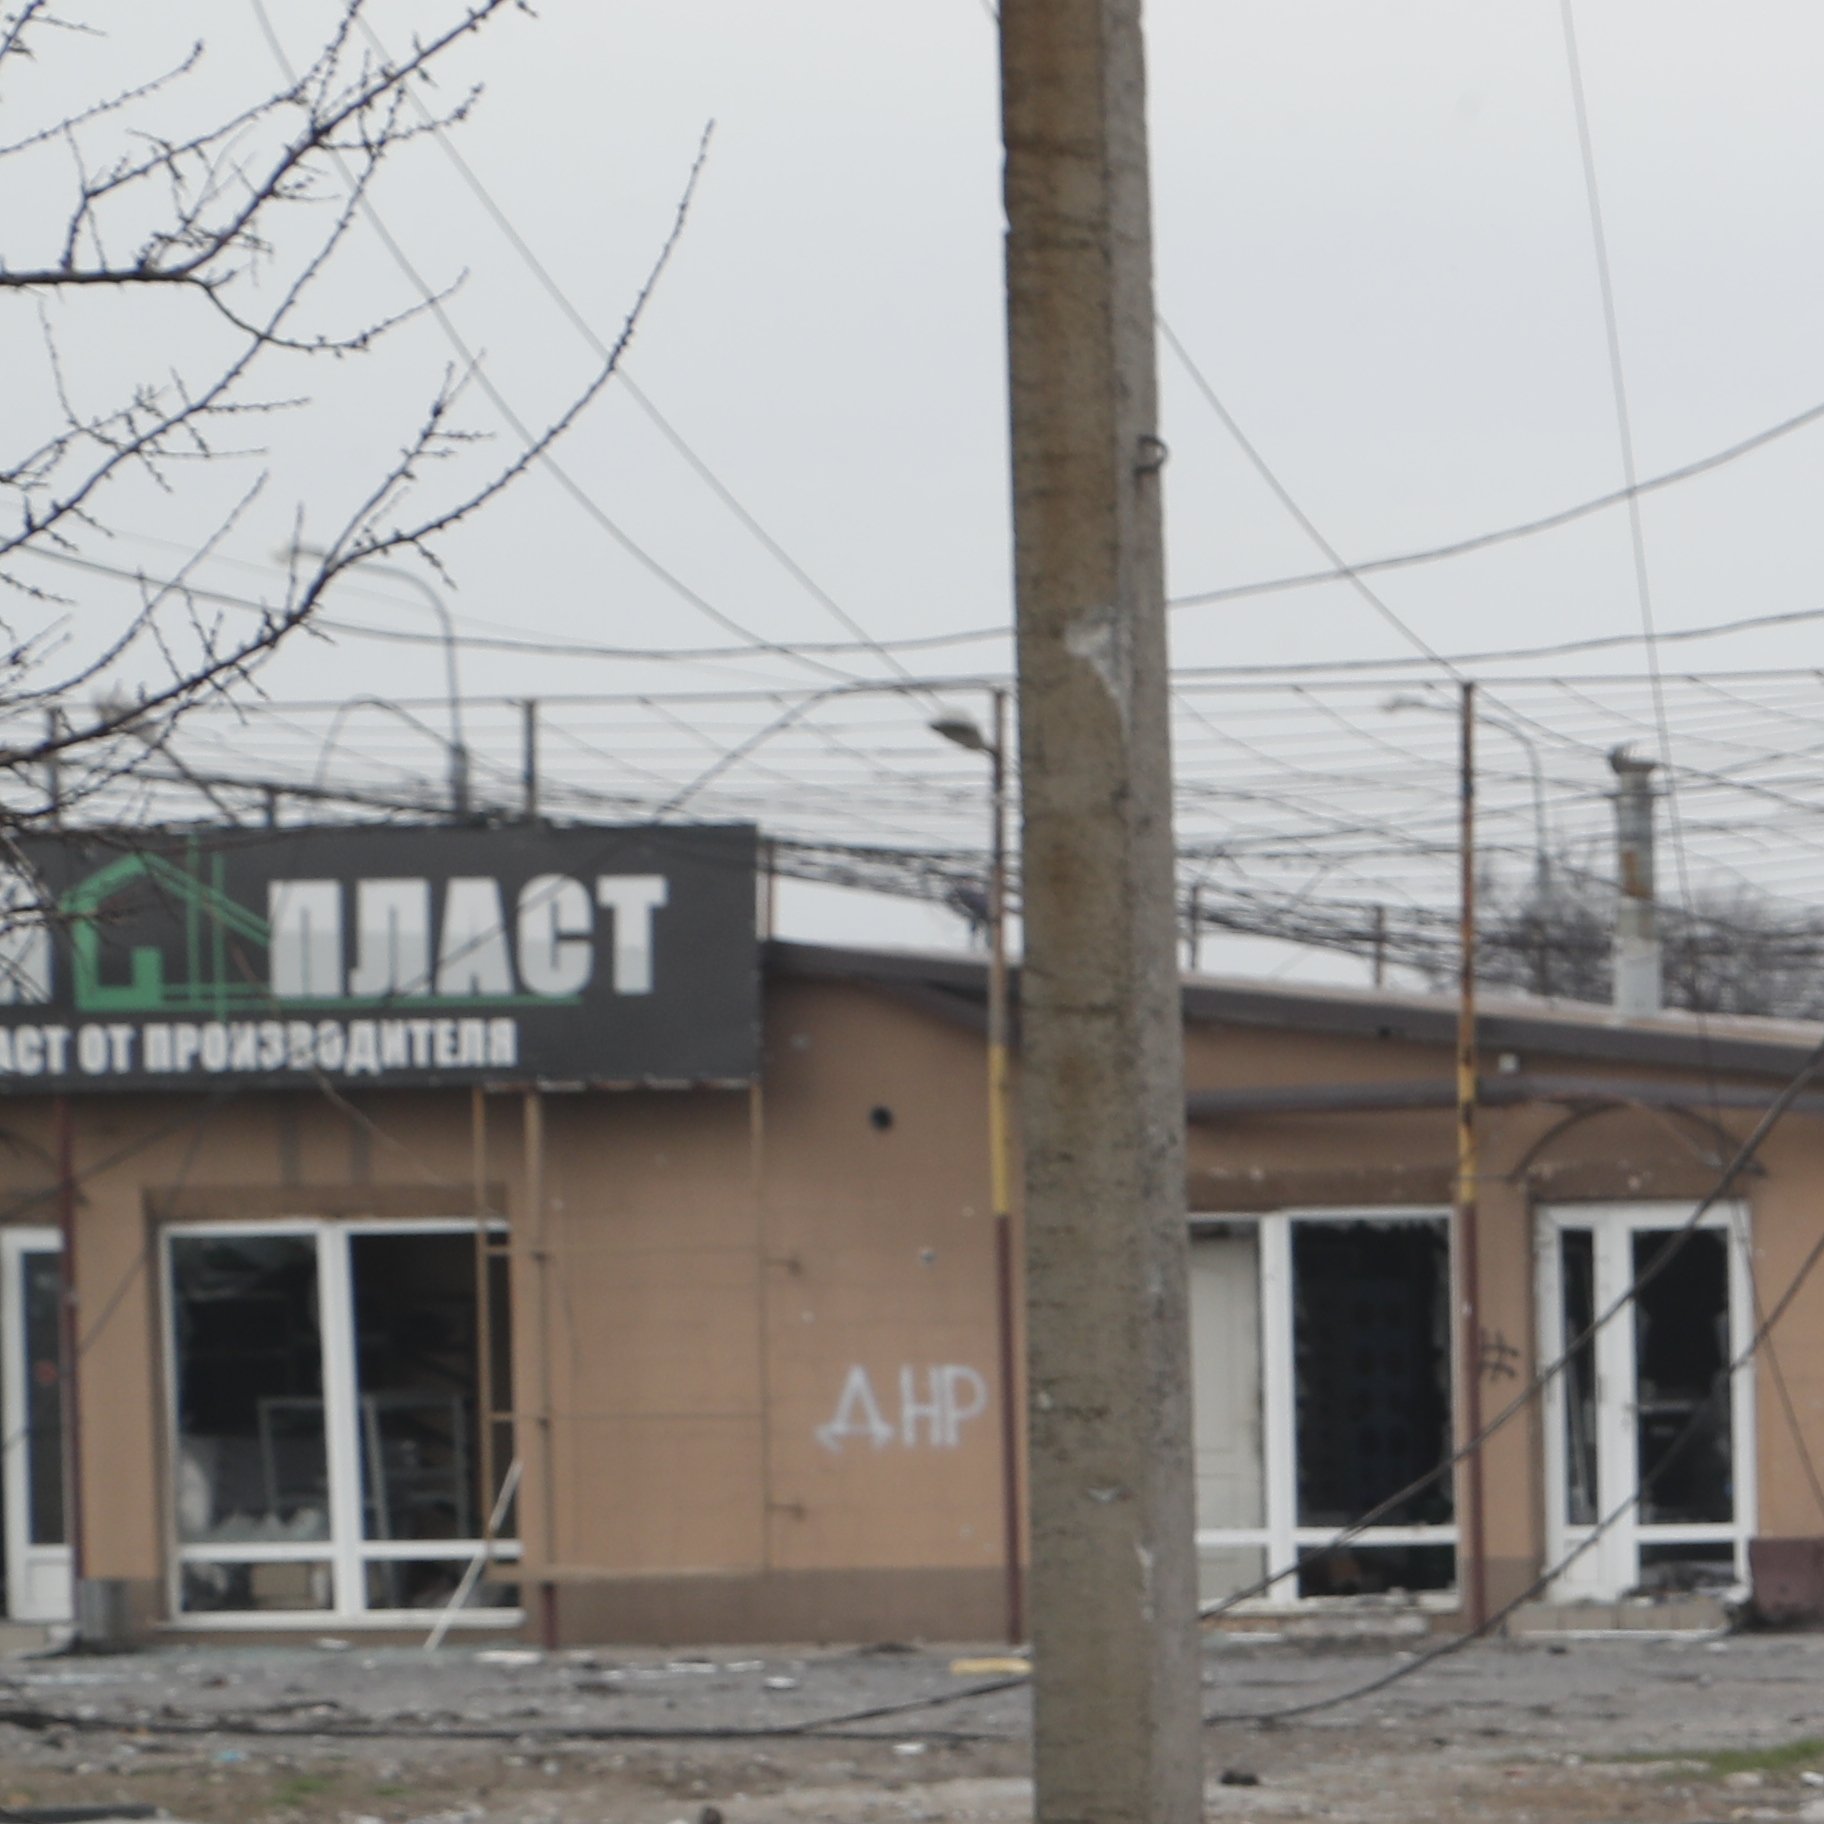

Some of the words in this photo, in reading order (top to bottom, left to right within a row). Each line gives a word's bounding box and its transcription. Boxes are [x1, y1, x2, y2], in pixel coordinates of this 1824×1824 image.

[267, 873, 668, 998] ПЛАСТ
[77, 1022, 137, 1076] ОТ
[142, 1017, 519, 1077] ПРОИЗВОДИТЕЛЯ
[814, 1364, 988, 1456] ДНР
